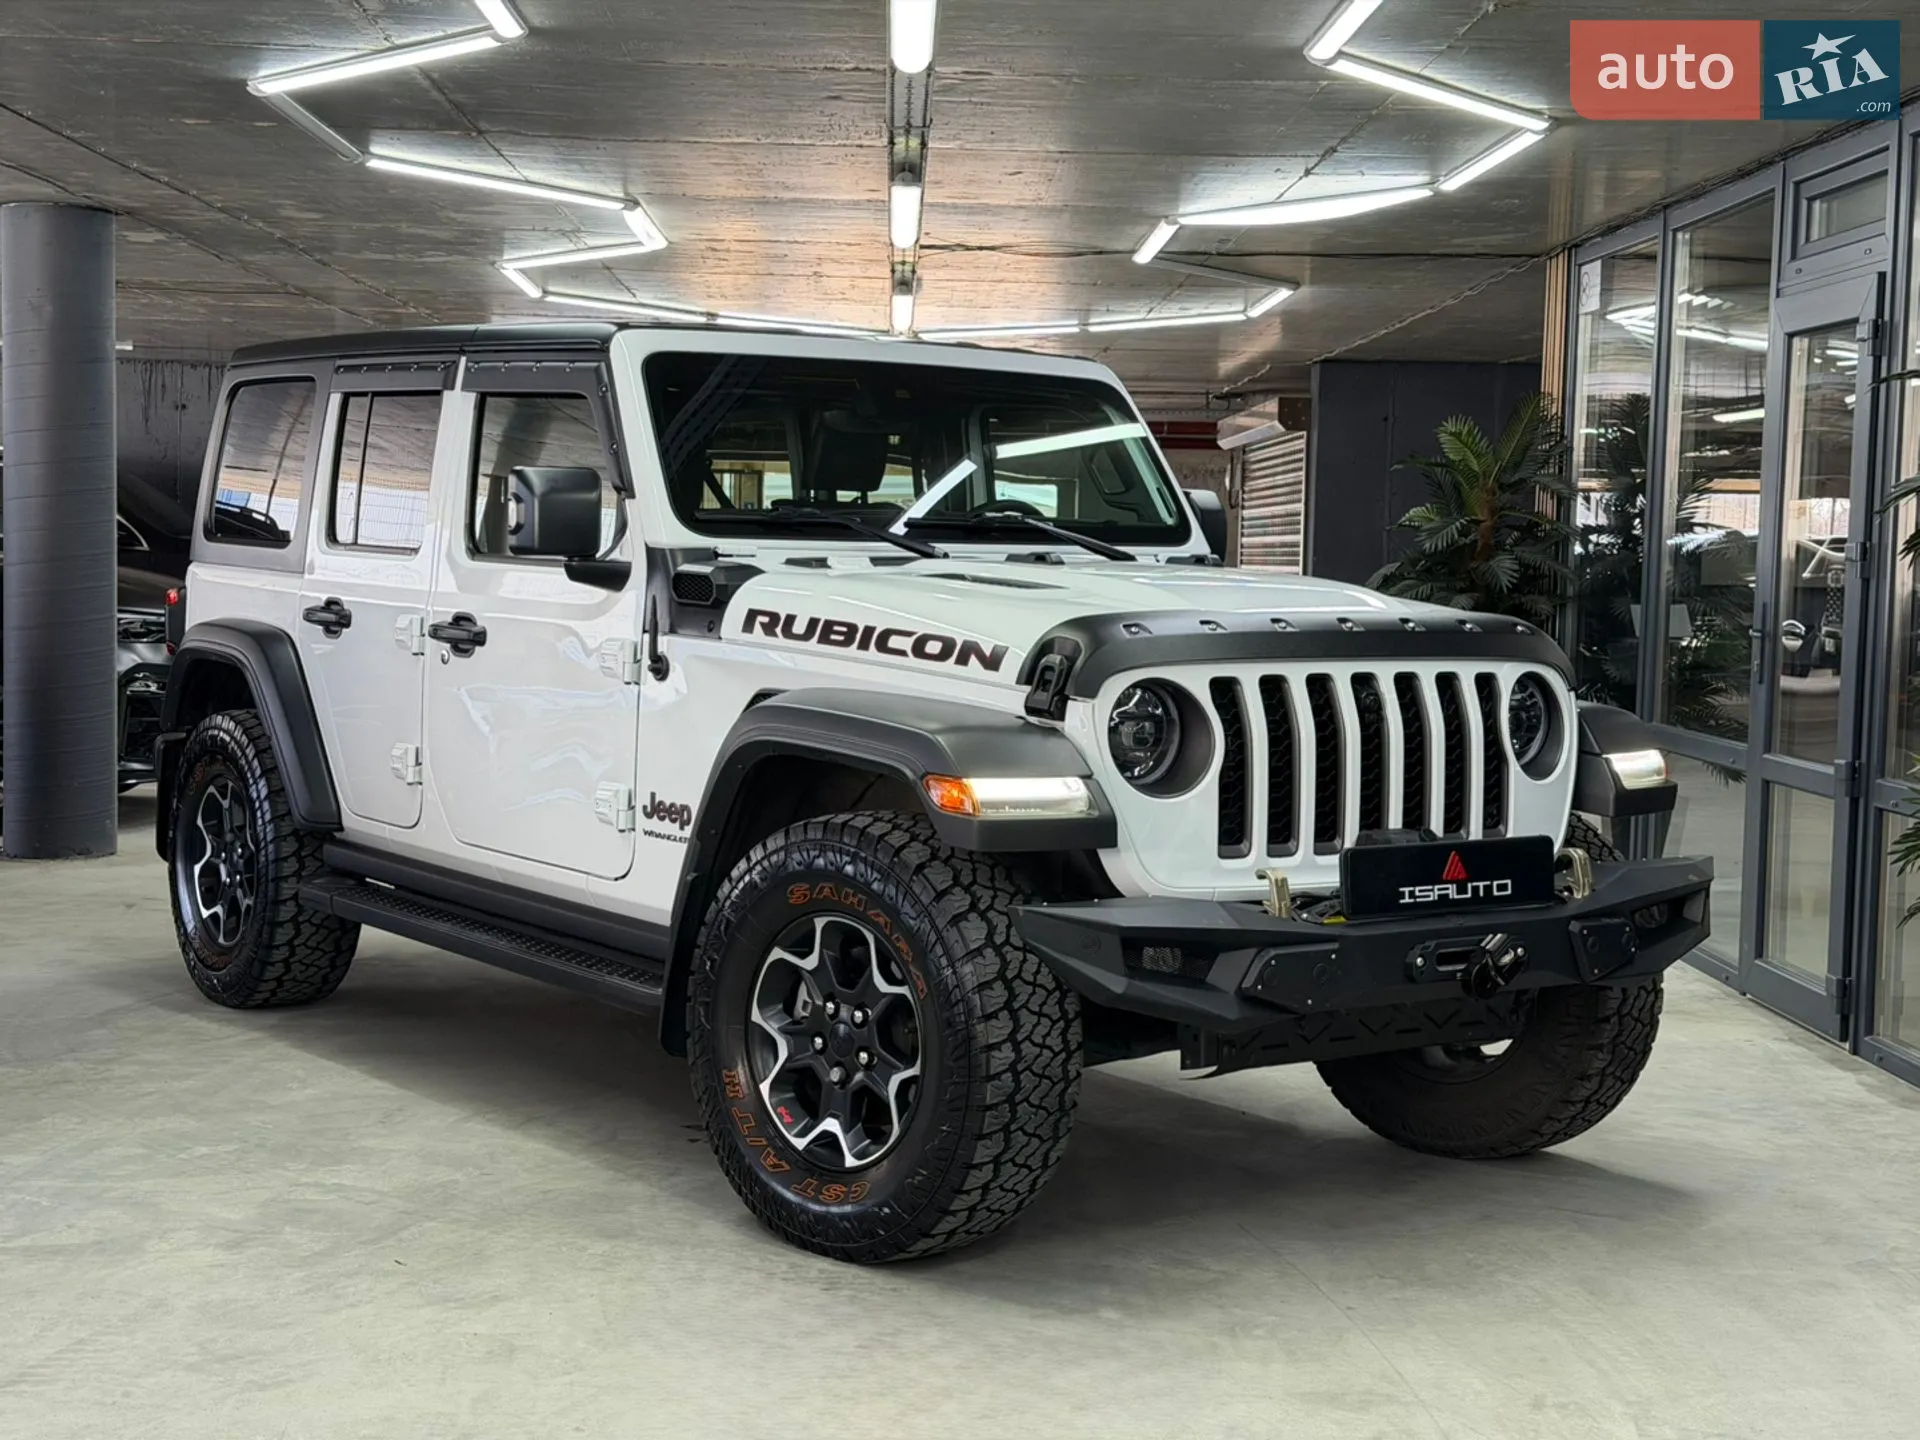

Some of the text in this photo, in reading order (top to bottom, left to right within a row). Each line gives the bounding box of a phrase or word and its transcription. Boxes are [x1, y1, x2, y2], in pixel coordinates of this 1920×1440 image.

[741, 607, 1009, 673] RUBICON
[642, 791, 692, 831] Jeep
[1398, 879, 1512, 904] ISAUTO
[787, 882, 928, 1000] SAHARA
[790, 1177, 871, 1204] CST
